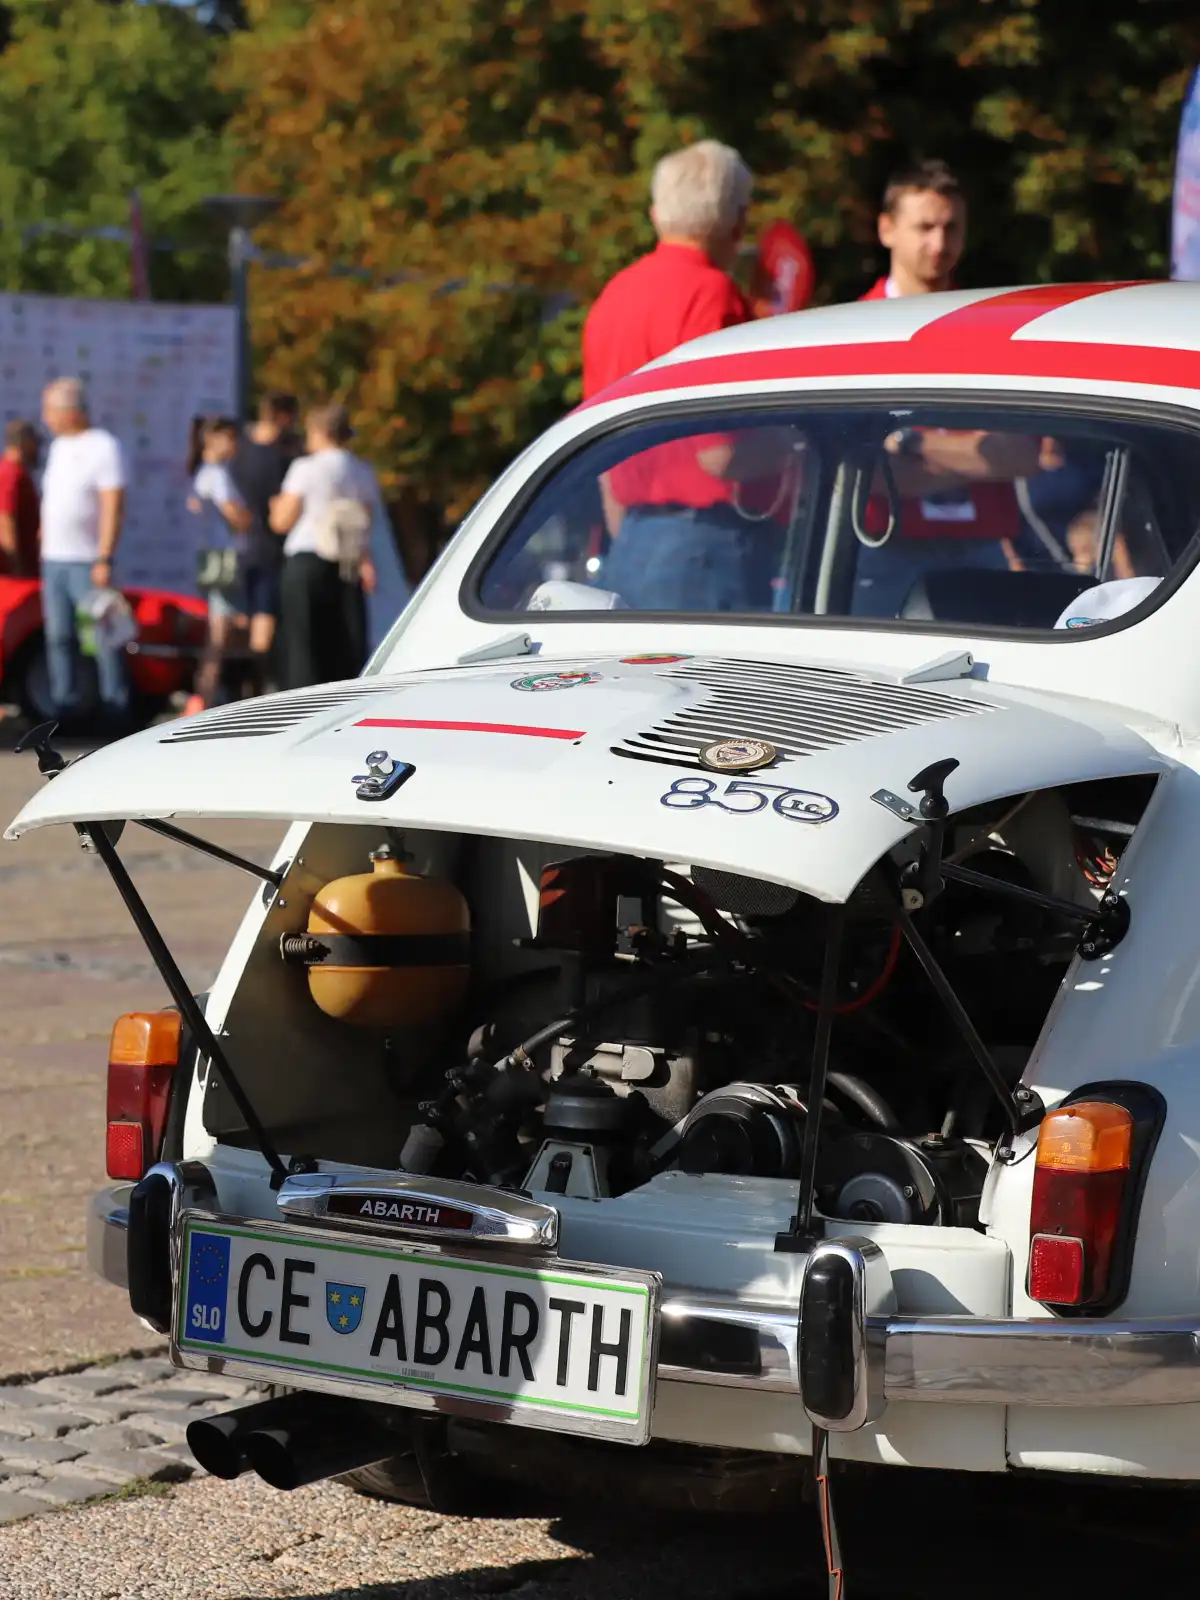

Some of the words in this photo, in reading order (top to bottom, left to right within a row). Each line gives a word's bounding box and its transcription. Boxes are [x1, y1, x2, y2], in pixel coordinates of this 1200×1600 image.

[660, 777, 840, 824] 850
[359, 1199, 440, 1224] ABARTH
[191, 1303, 221, 1332] SLO
[237, 1252, 316, 1346] CE
[369, 1273, 631, 1396] ABARTH
